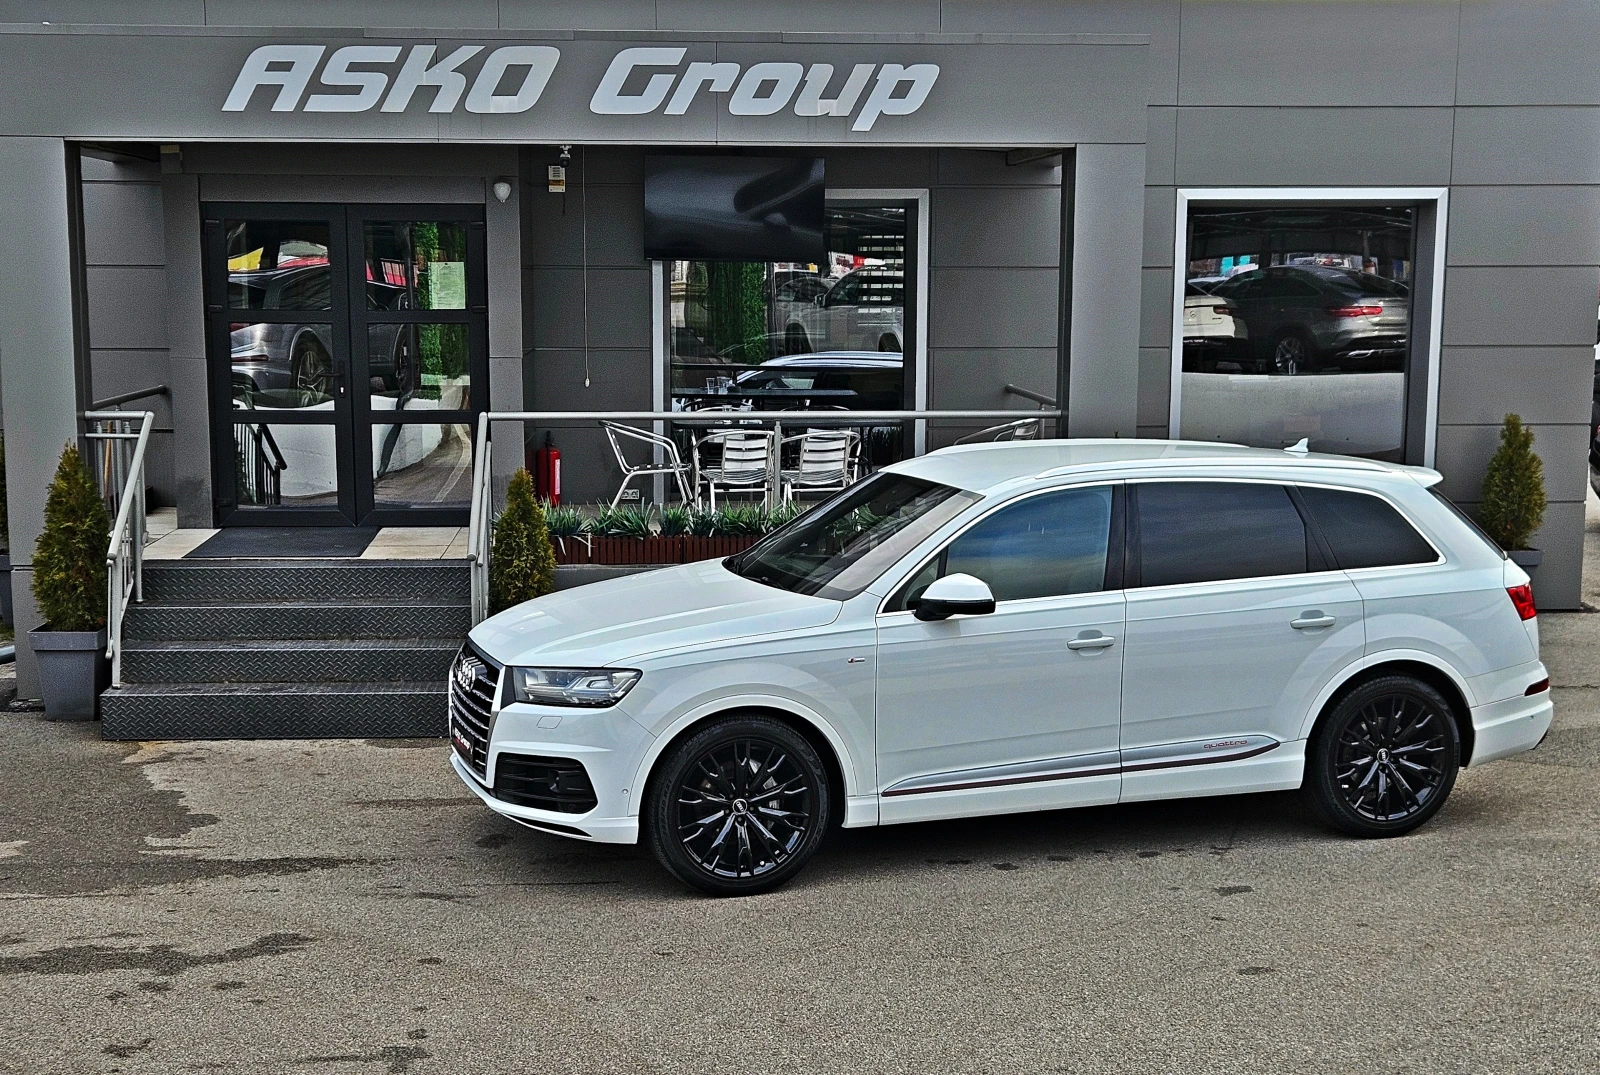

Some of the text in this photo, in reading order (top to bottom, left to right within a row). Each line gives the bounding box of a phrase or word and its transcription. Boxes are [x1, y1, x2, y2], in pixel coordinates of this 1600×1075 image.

[221, 44, 940, 132] ASKO Group
[1203, 740, 1247, 749] quattro
